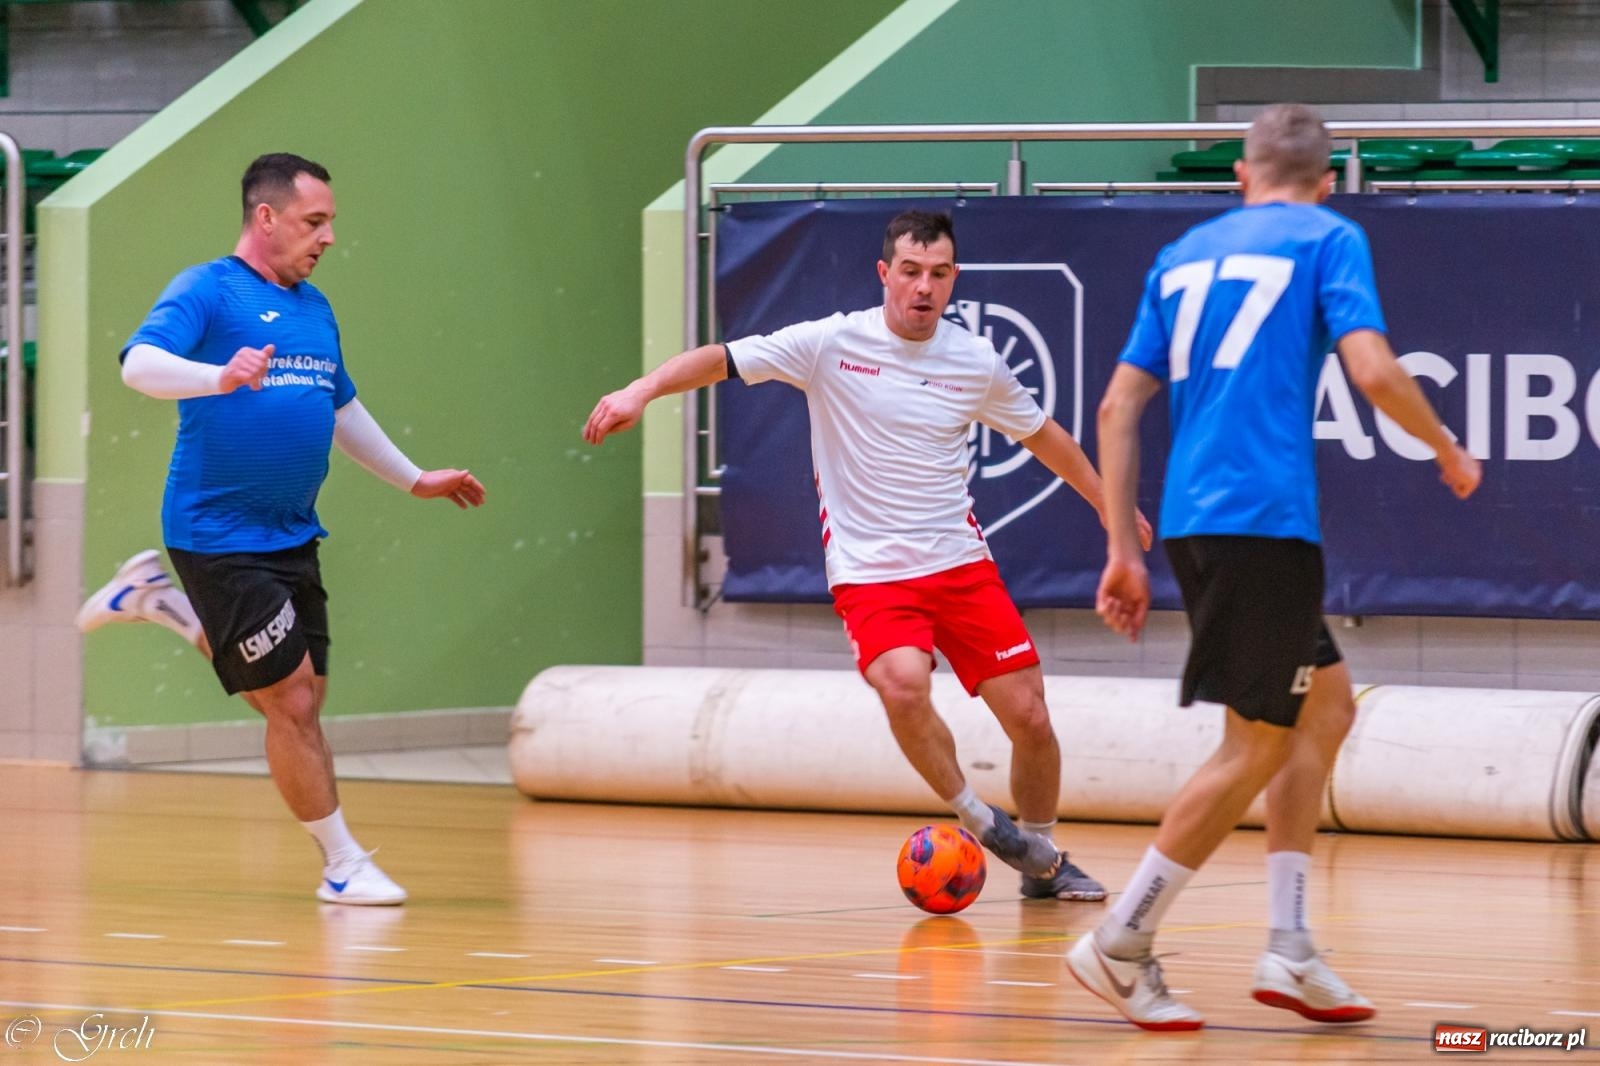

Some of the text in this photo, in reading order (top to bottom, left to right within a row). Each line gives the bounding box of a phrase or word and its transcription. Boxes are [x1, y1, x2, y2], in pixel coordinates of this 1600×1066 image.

[259, 373, 314, 386] etallbau
[839, 359, 881, 377] hummel
[1312, 351, 1600, 461] ACIB
[238, 627, 274, 664] LSM
